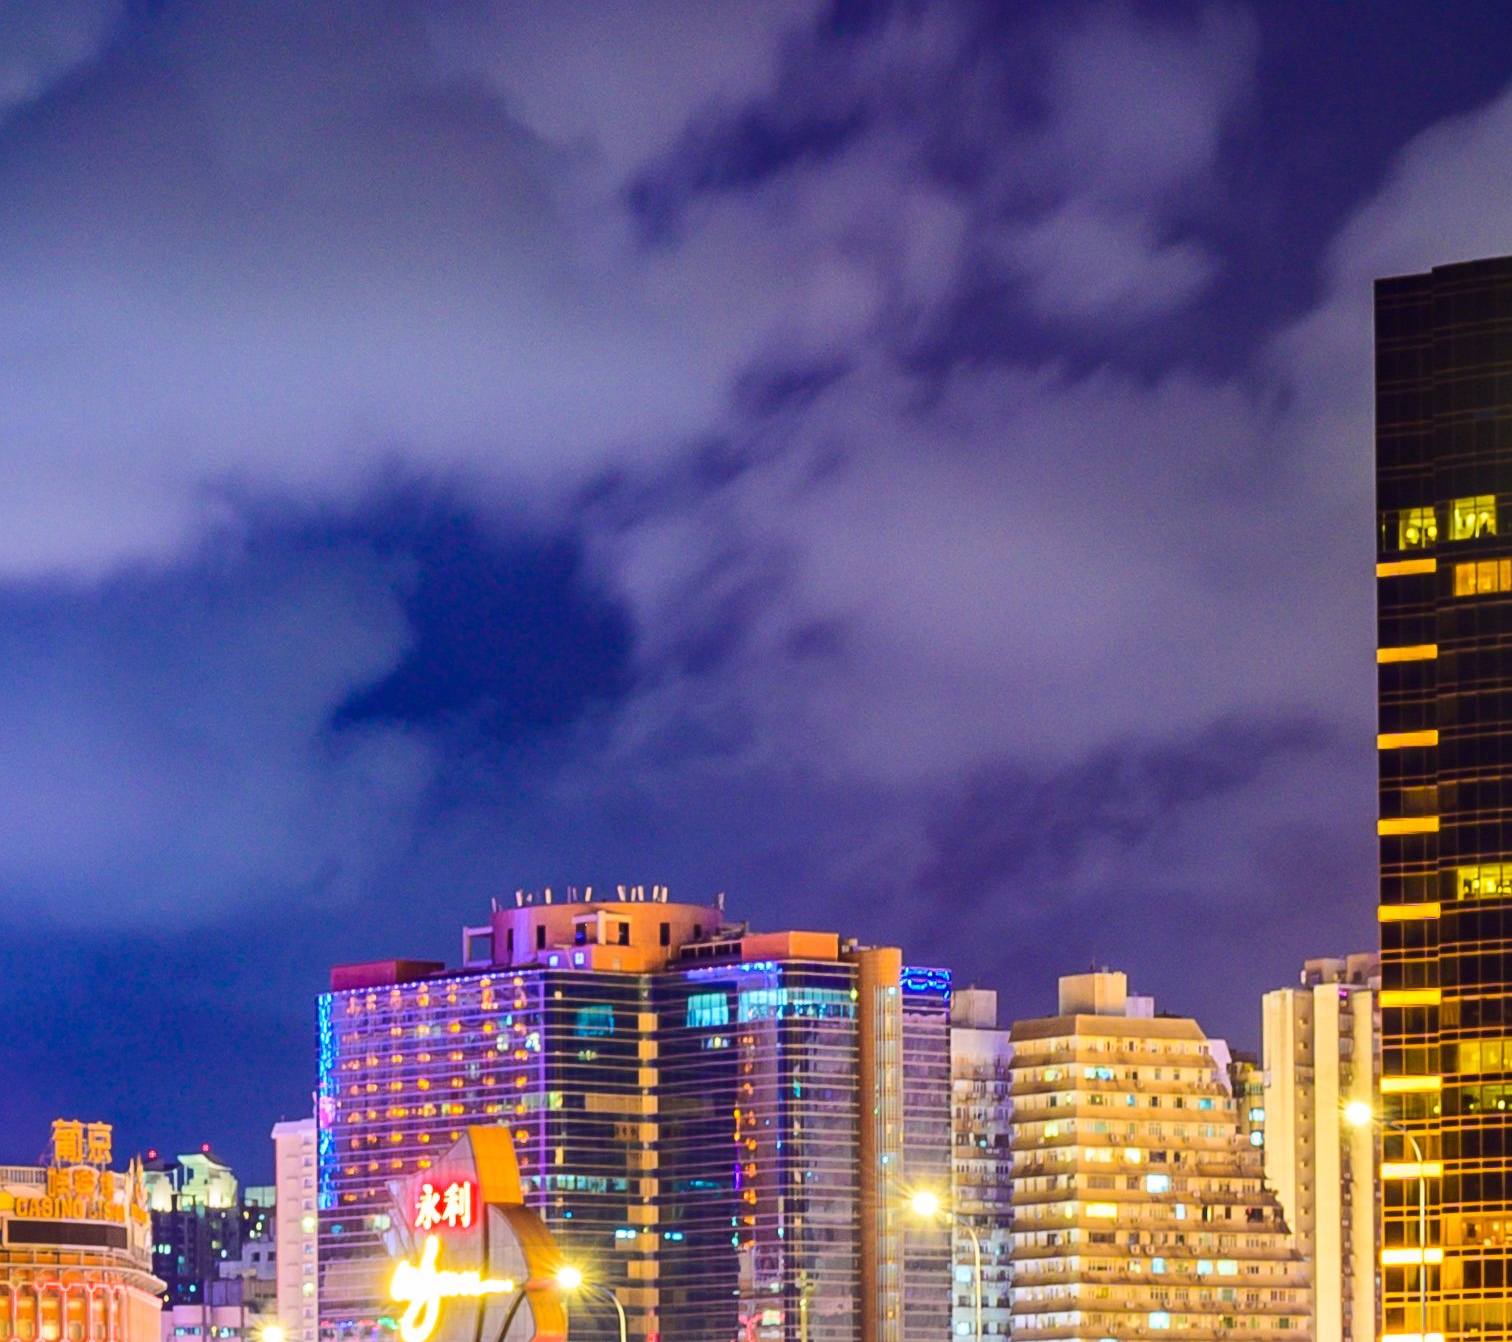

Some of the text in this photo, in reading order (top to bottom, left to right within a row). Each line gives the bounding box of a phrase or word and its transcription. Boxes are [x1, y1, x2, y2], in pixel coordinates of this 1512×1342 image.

[51, 1118, 113, 1164] 葡京
[15, 1196, 84, 1219] CASINO
[414, 1180, 472, 1230] 永利
